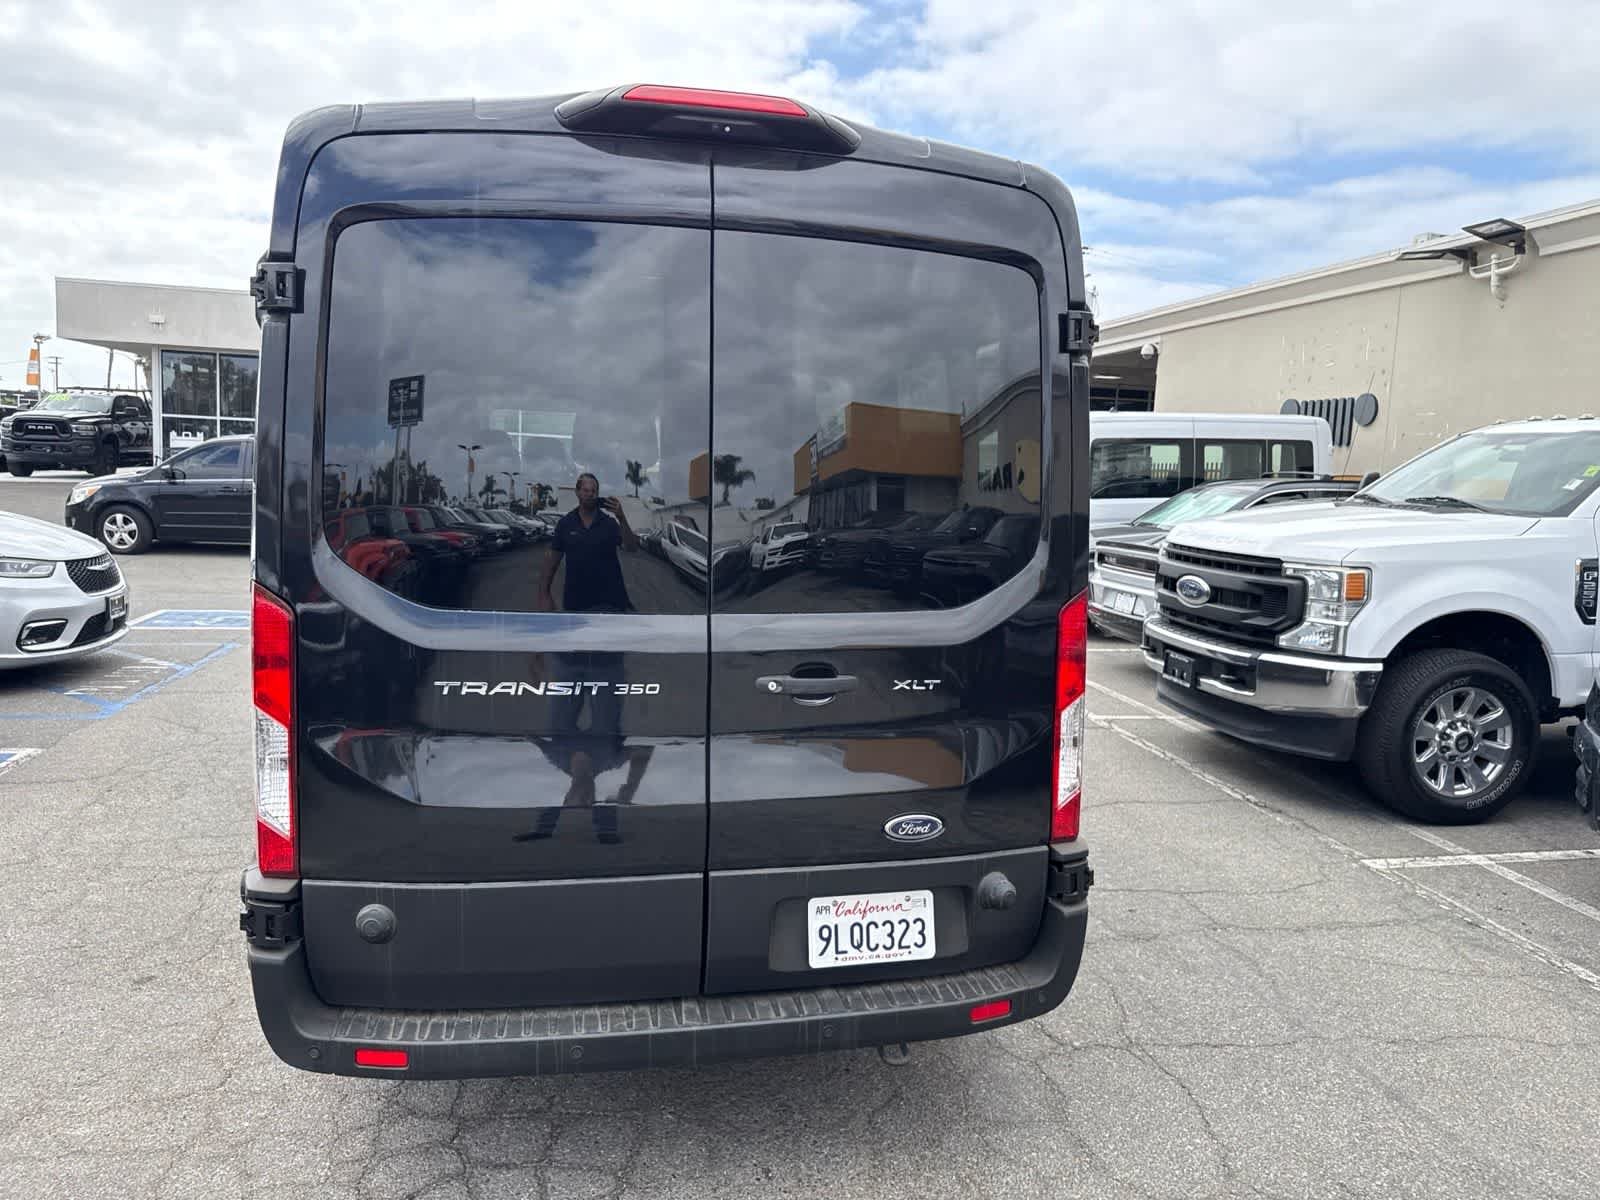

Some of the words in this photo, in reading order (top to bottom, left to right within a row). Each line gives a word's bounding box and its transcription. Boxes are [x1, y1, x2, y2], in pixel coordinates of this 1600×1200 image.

[434, 681, 608, 696] TRANSIT
[614, 683, 661, 695] 350
[892, 679, 941, 690] XLT
[898, 820, 930, 835] Ford
[816, 905, 831, 916] APR
[834, 900, 912, 920] California
[818, 917, 926, 956] 9LQC323
